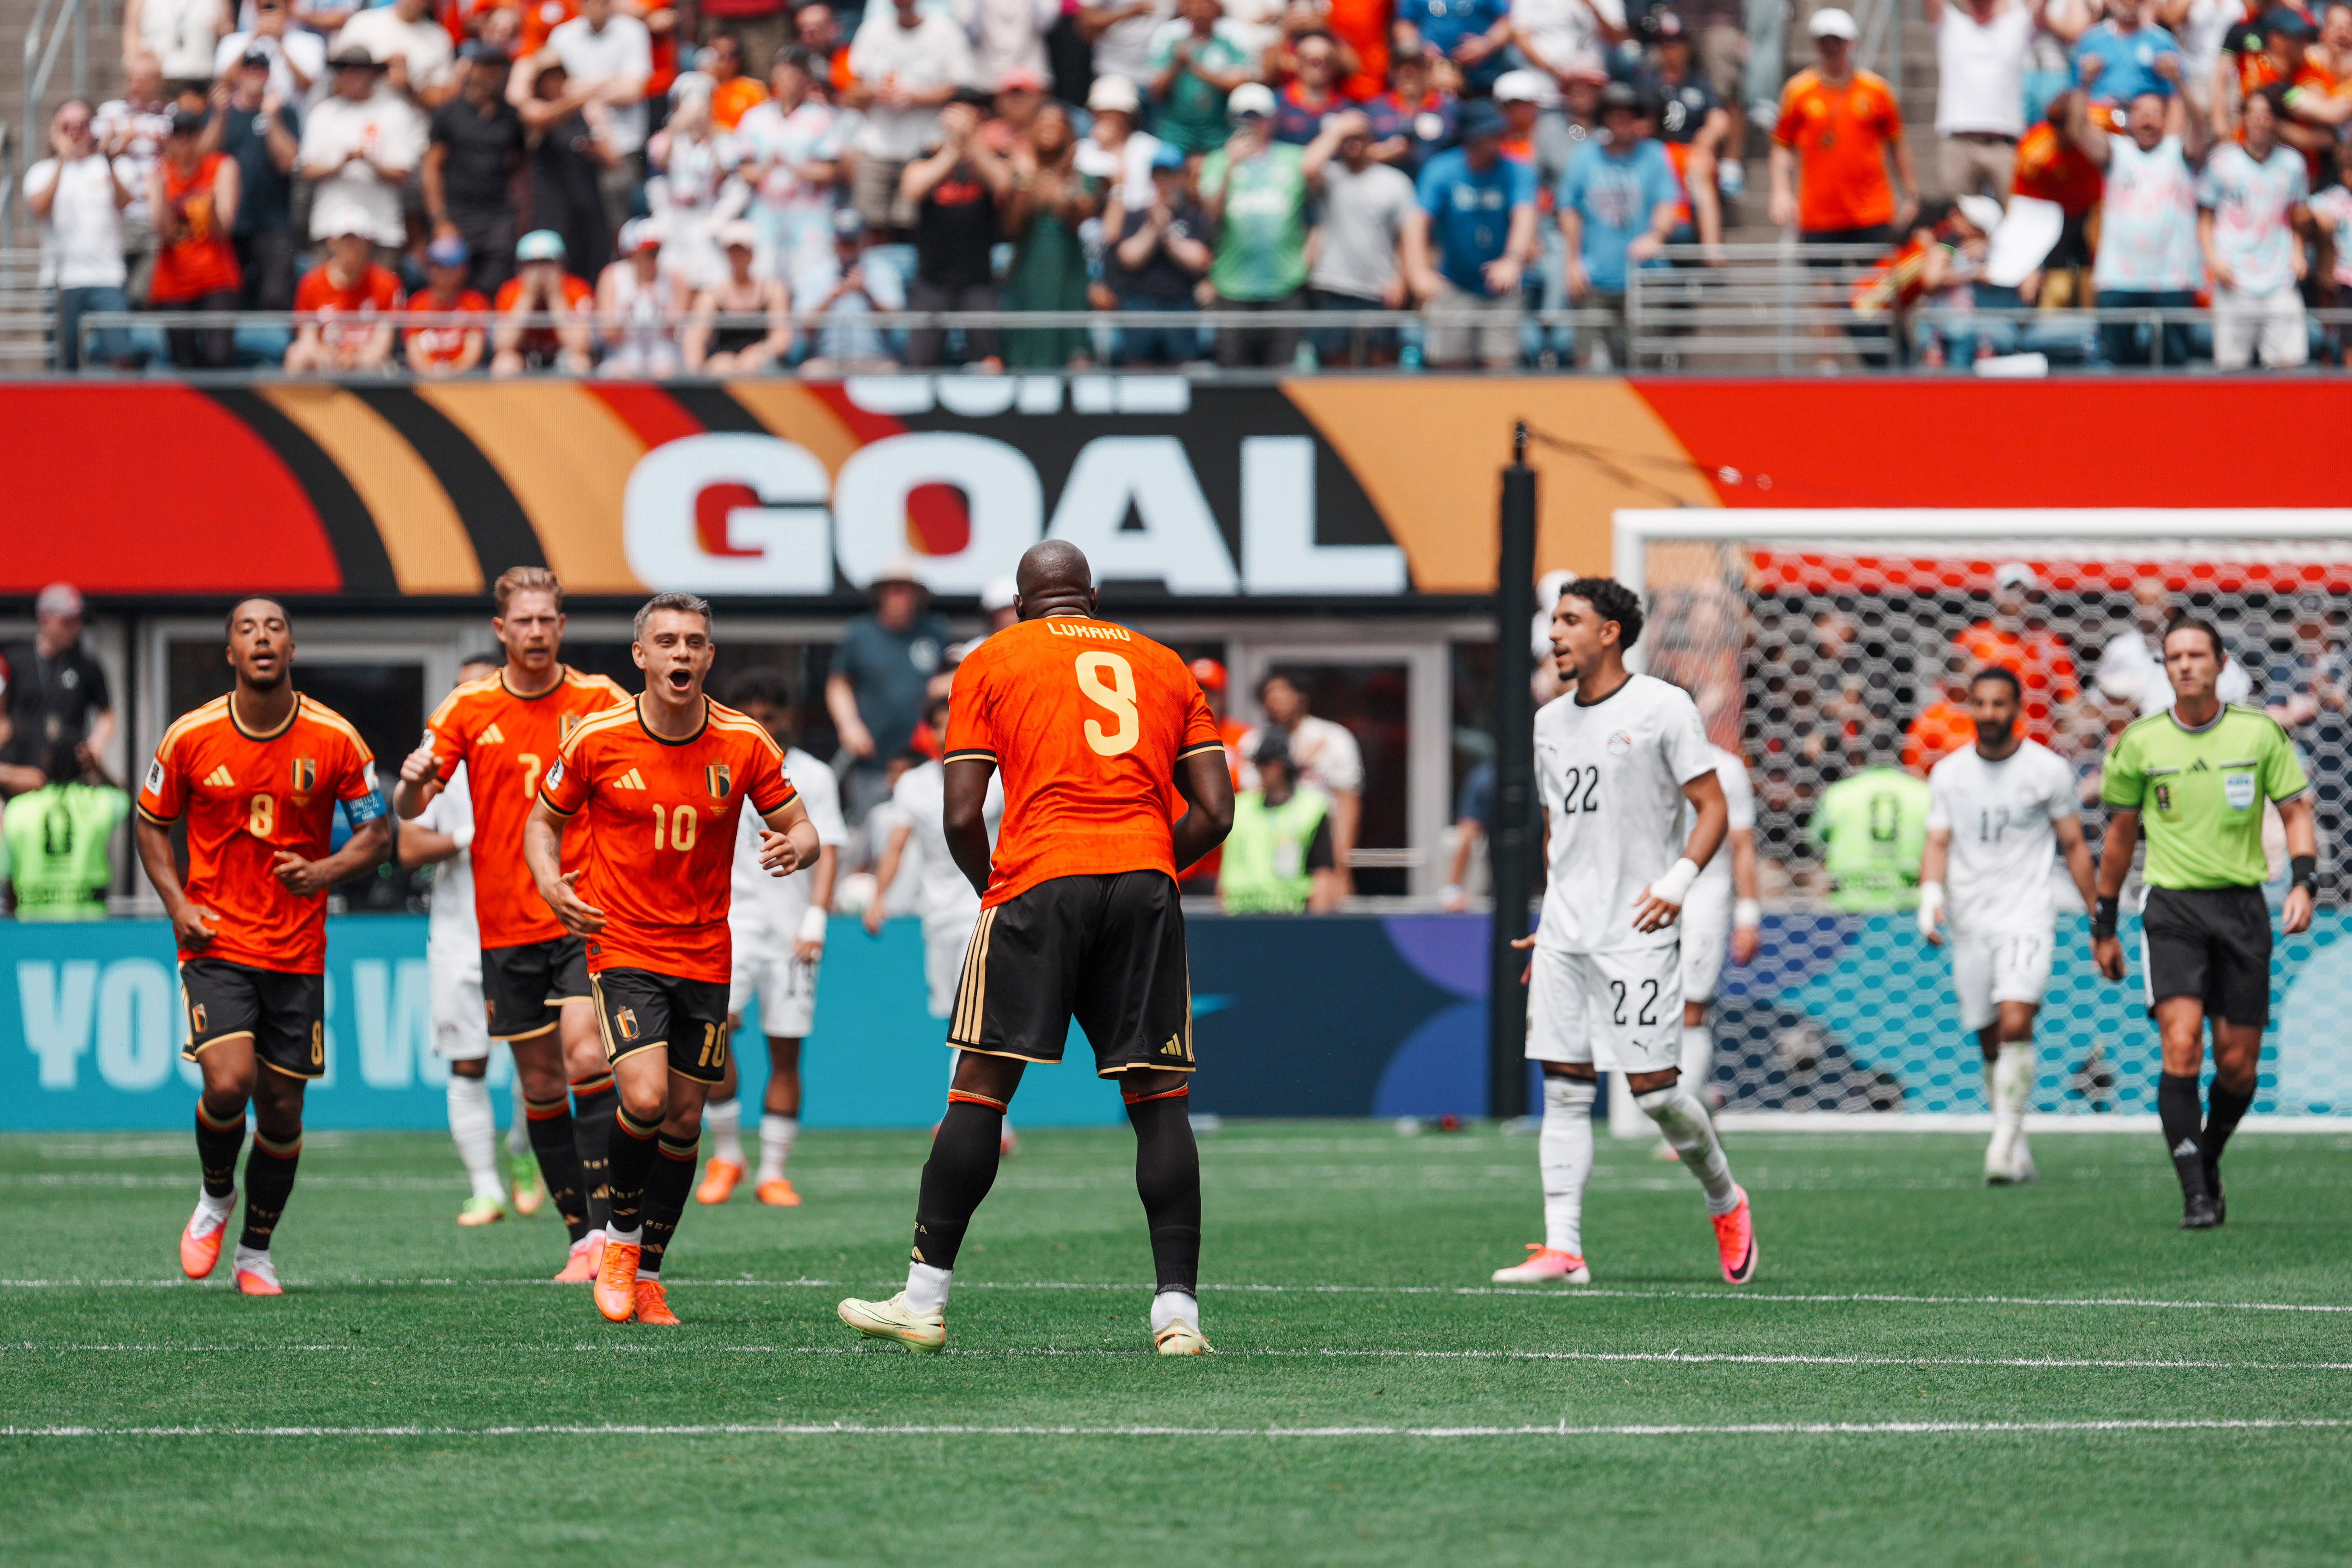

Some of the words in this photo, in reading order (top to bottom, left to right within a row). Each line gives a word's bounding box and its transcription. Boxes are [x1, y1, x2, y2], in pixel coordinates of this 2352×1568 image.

[624, 432, 1406, 595] GOAL
[1046, 622, 1131, 641] LUKAKU
[1075, 651, 1139, 756] 9
[517, 753, 541, 799] 7
[1565, 766, 1598, 813] 22
[250, 794, 274, 838] 8
[653, 804, 697, 851] 10
[1980, 808, 2009, 844] 17
[2011, 936, 2040, 970] 17
[1611, 979, 1658, 1025] 22
[311, 1020, 324, 1065] 8
[698, 1021, 727, 1067] 10
